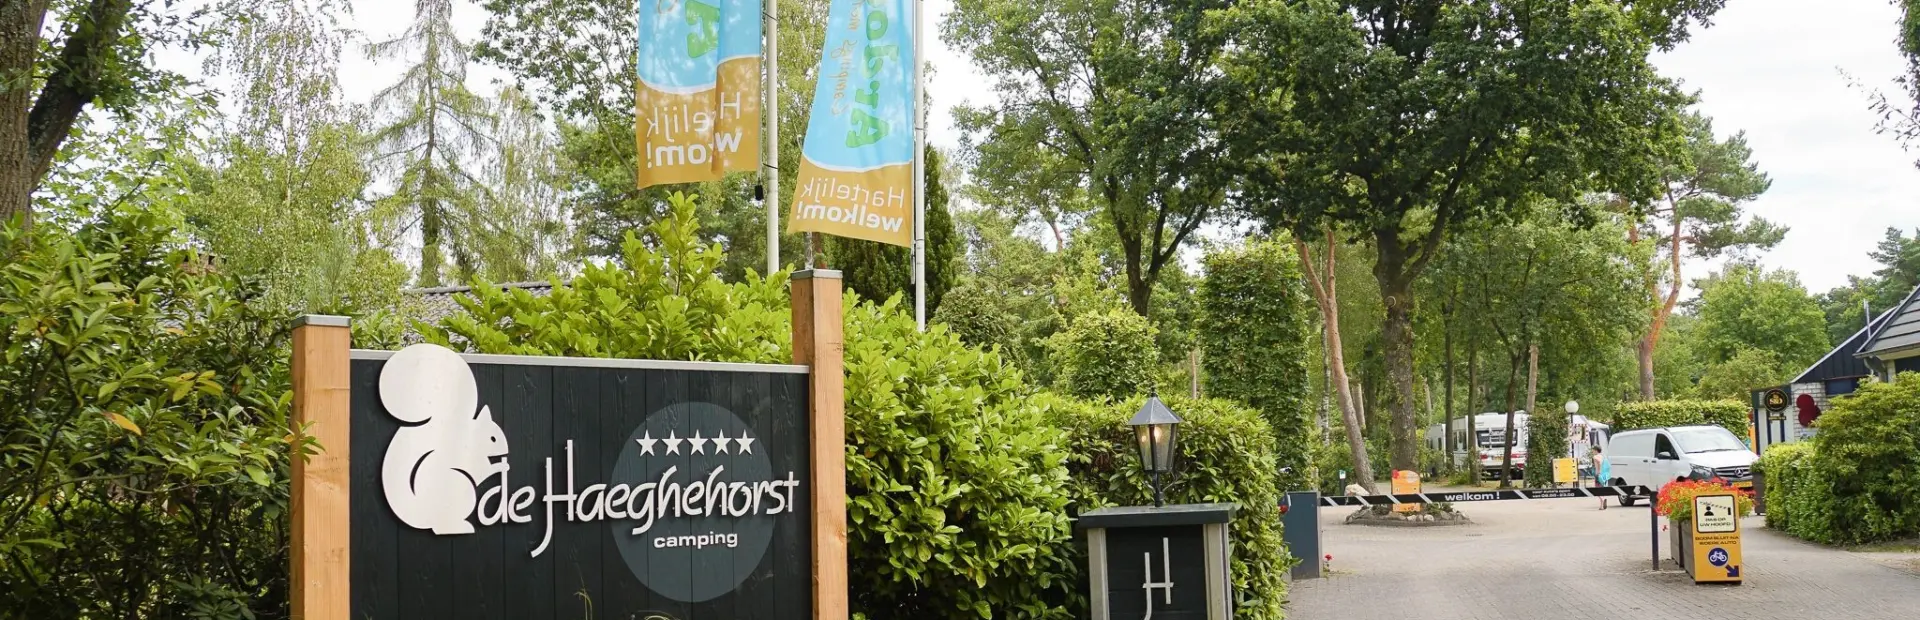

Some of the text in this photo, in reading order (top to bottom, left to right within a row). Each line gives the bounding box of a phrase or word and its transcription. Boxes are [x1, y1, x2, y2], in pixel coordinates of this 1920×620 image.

[477, 439, 799, 558] de Haeghehorst
[1444, 491, 1500, 501] welkom!
[653, 530, 738, 550] camping
